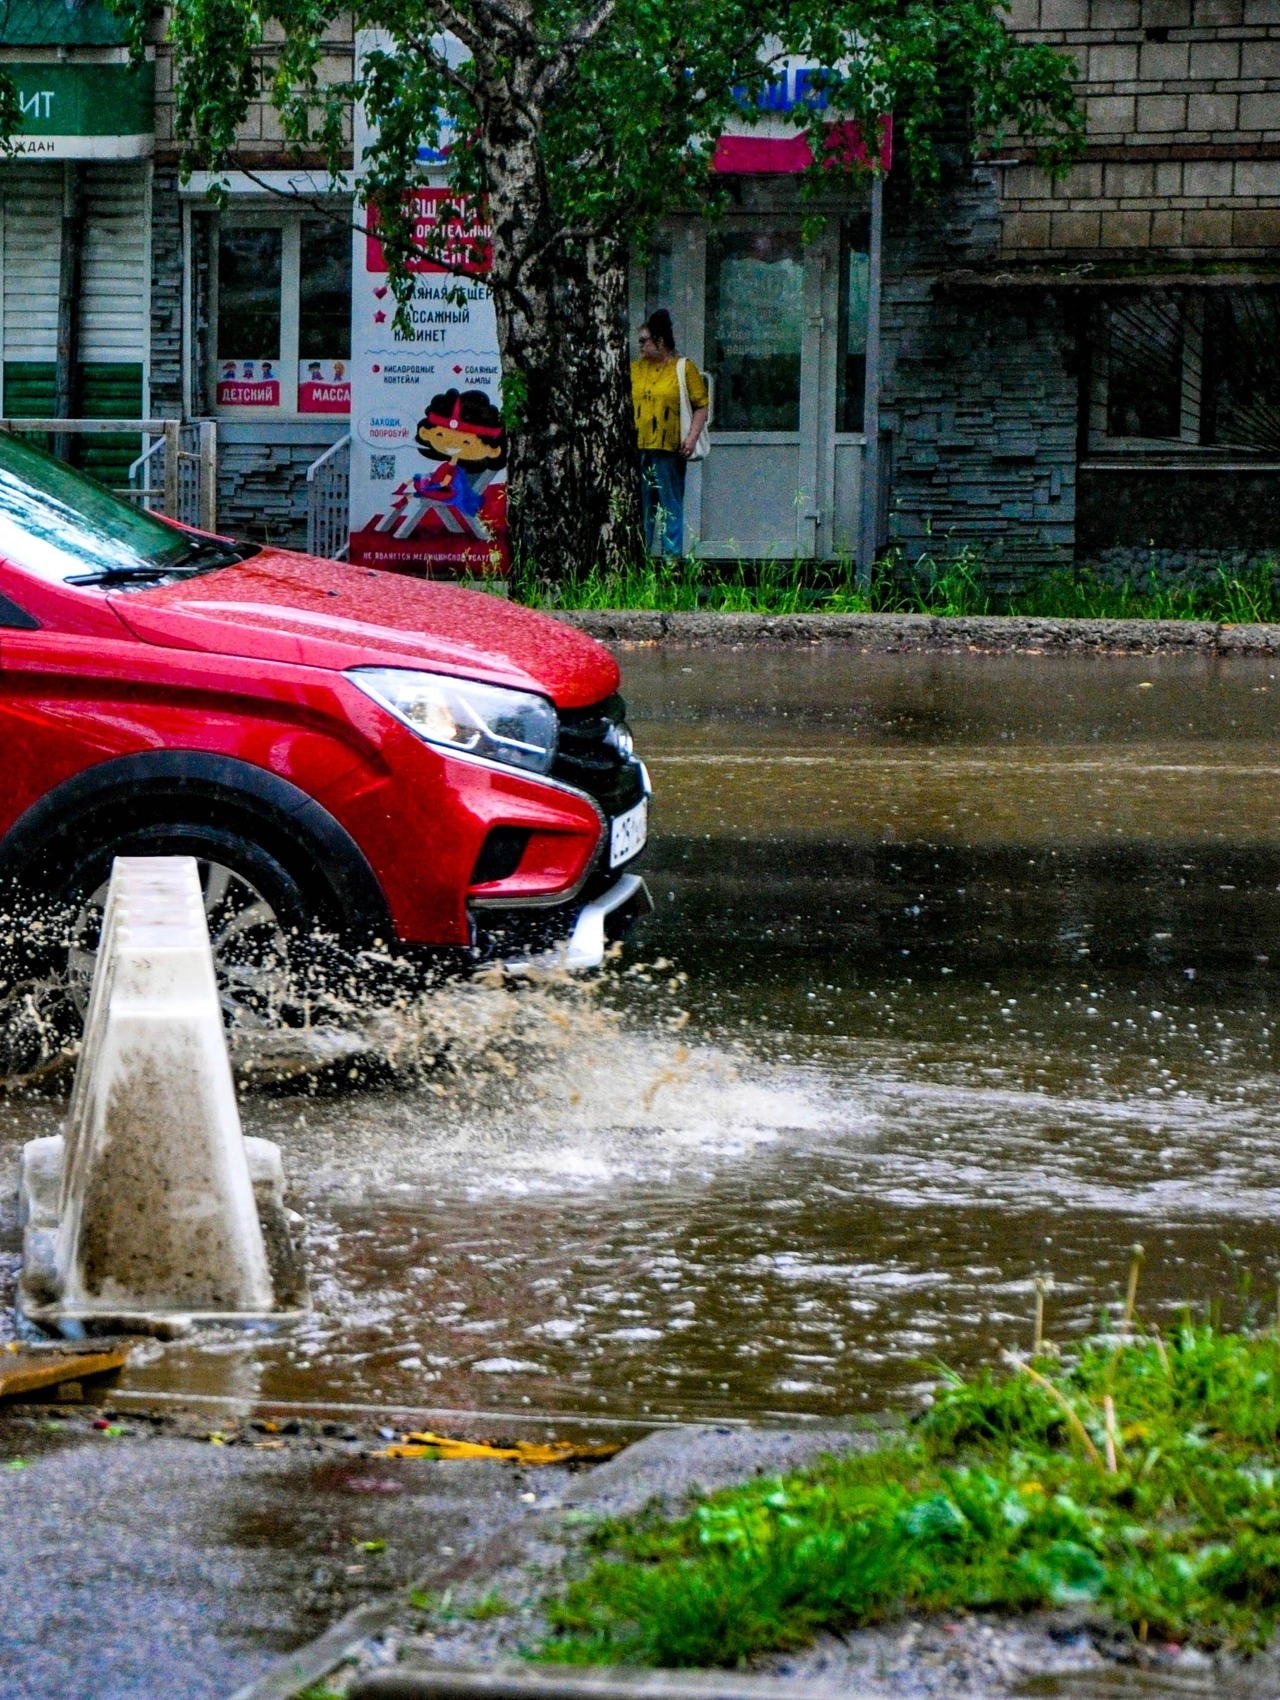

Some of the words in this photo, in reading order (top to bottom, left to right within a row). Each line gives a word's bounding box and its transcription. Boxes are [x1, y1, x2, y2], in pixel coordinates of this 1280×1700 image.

[394, 308, 470, 324] АССАЖНЫЙ
[383, 365, 435, 374] КИСЛОРОДНЫЕ
[383, 375, 420, 384] КОКТЕЙЛИ
[464, 377, 491, 385] ЛАМПЫ
[222, 386, 273, 401] ДЕТСКИЙ
[312, 388, 351, 402] МАССА
[370, 428, 410, 438] ПОПРОБУЙ!
